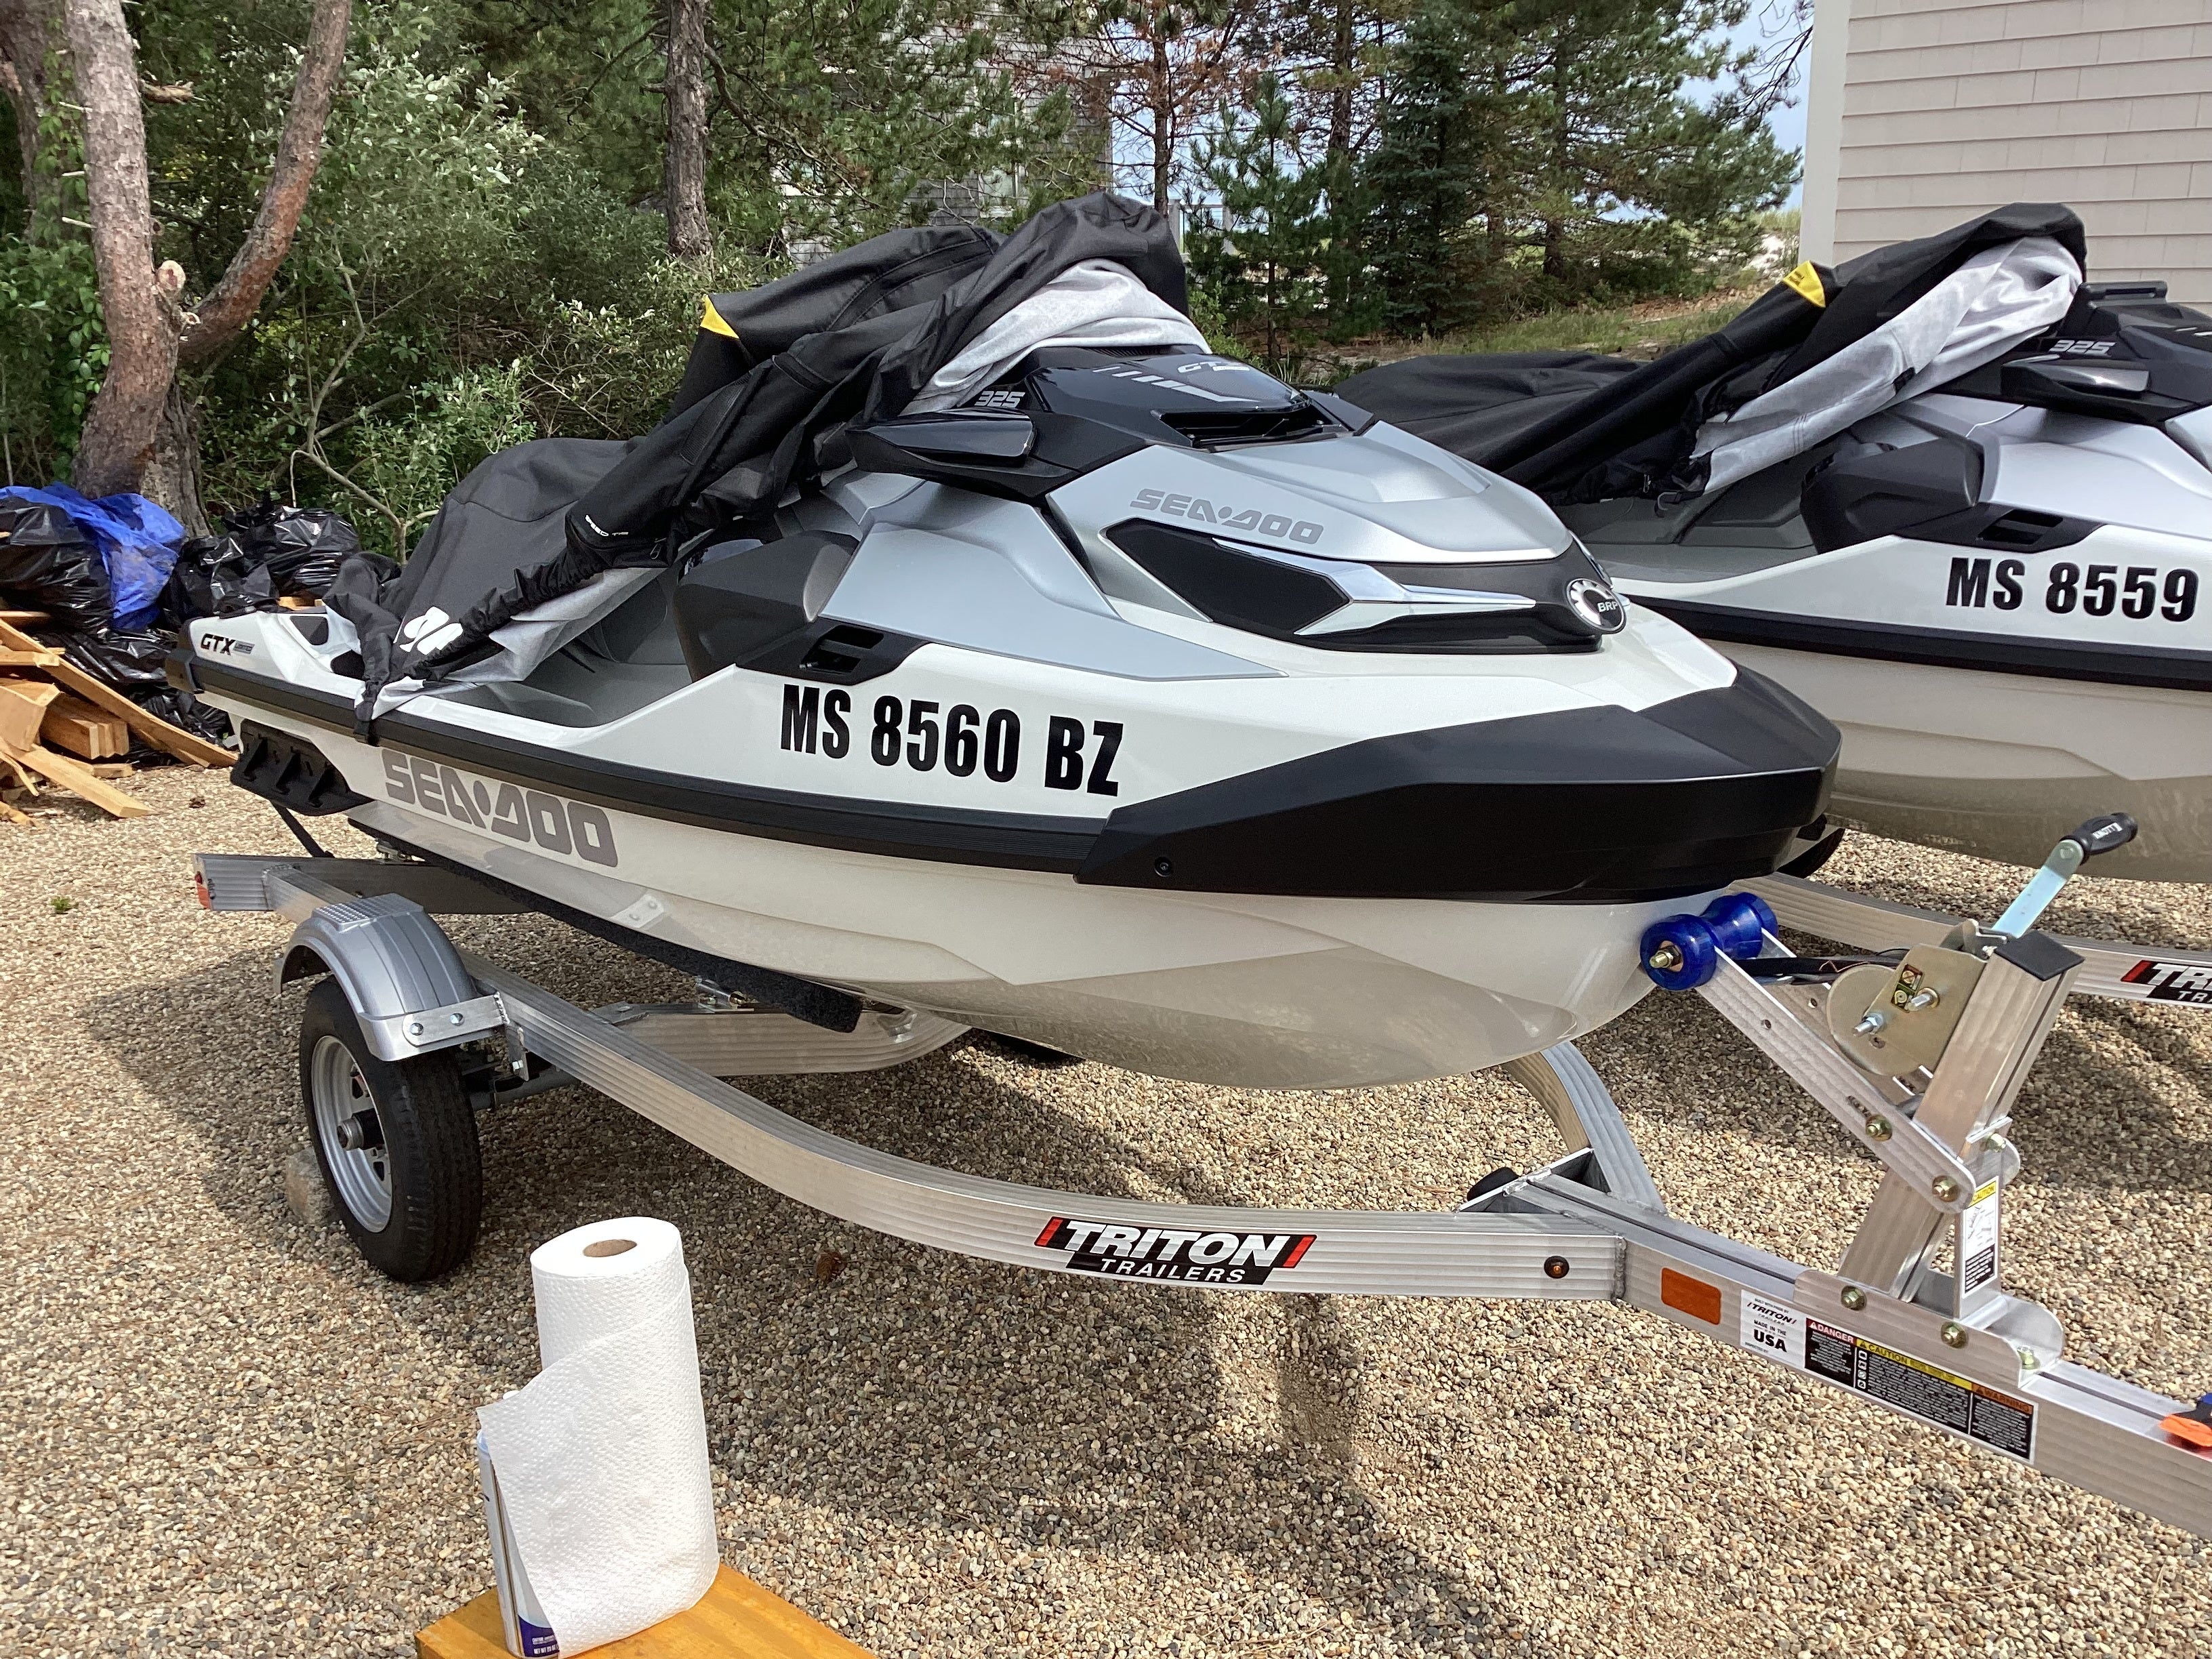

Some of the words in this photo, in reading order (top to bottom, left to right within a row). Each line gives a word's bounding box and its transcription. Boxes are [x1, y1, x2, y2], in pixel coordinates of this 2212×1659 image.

[2049, 340, 2116, 357] 325
[974, 391, 1025, 408] 325
[1946, 557, 2026, 610] MS
[2045, 562, 2199, 622] 8559
[1597, 601, 1618, 613] BRP
[201, 633, 236, 656] GTX
[781, 683, 851, 759] MS
[871, 695, 1021, 783] 8560
[1044, 715, 1124, 797] BZ
[1065, 1220, 1290, 1267] TRITON
[1100, 1258, 1246, 1283] TRAILERS
[1751, 1303, 1794, 1324] TRITON
[1754, 1319, 1768, 1329] MADE
[1777, 1328, 1787, 1336] THE
[1817, 1323, 1854, 1344] DANGER
[1753, 1328, 1788, 1353] USA
[1868, 1343, 1908, 1365] CAUTION
[1983, 1387, 2030, 1412] WARNING
